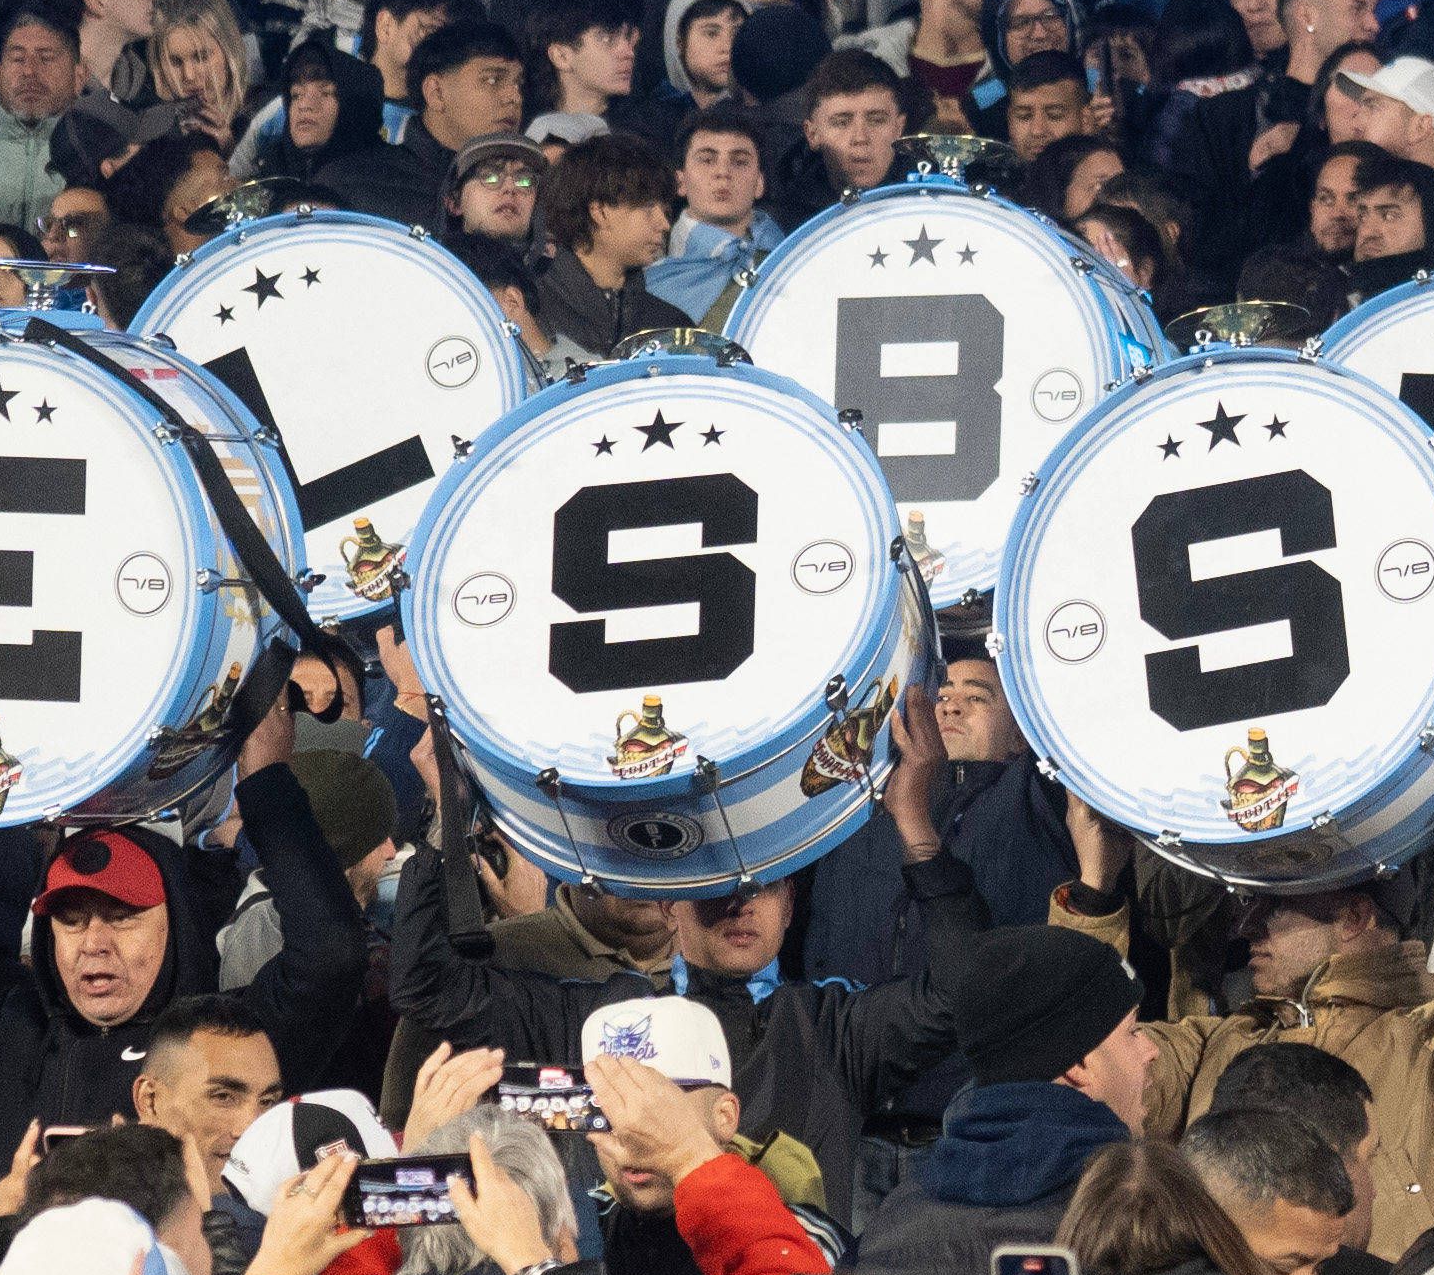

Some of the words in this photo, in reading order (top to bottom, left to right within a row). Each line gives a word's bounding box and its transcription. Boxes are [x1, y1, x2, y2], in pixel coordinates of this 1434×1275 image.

[202, 347, 435, 532] L
[835, 294, 1004, 503] B
[549, 473, 758, 693] S
[1131, 469, 1350, 731] S
